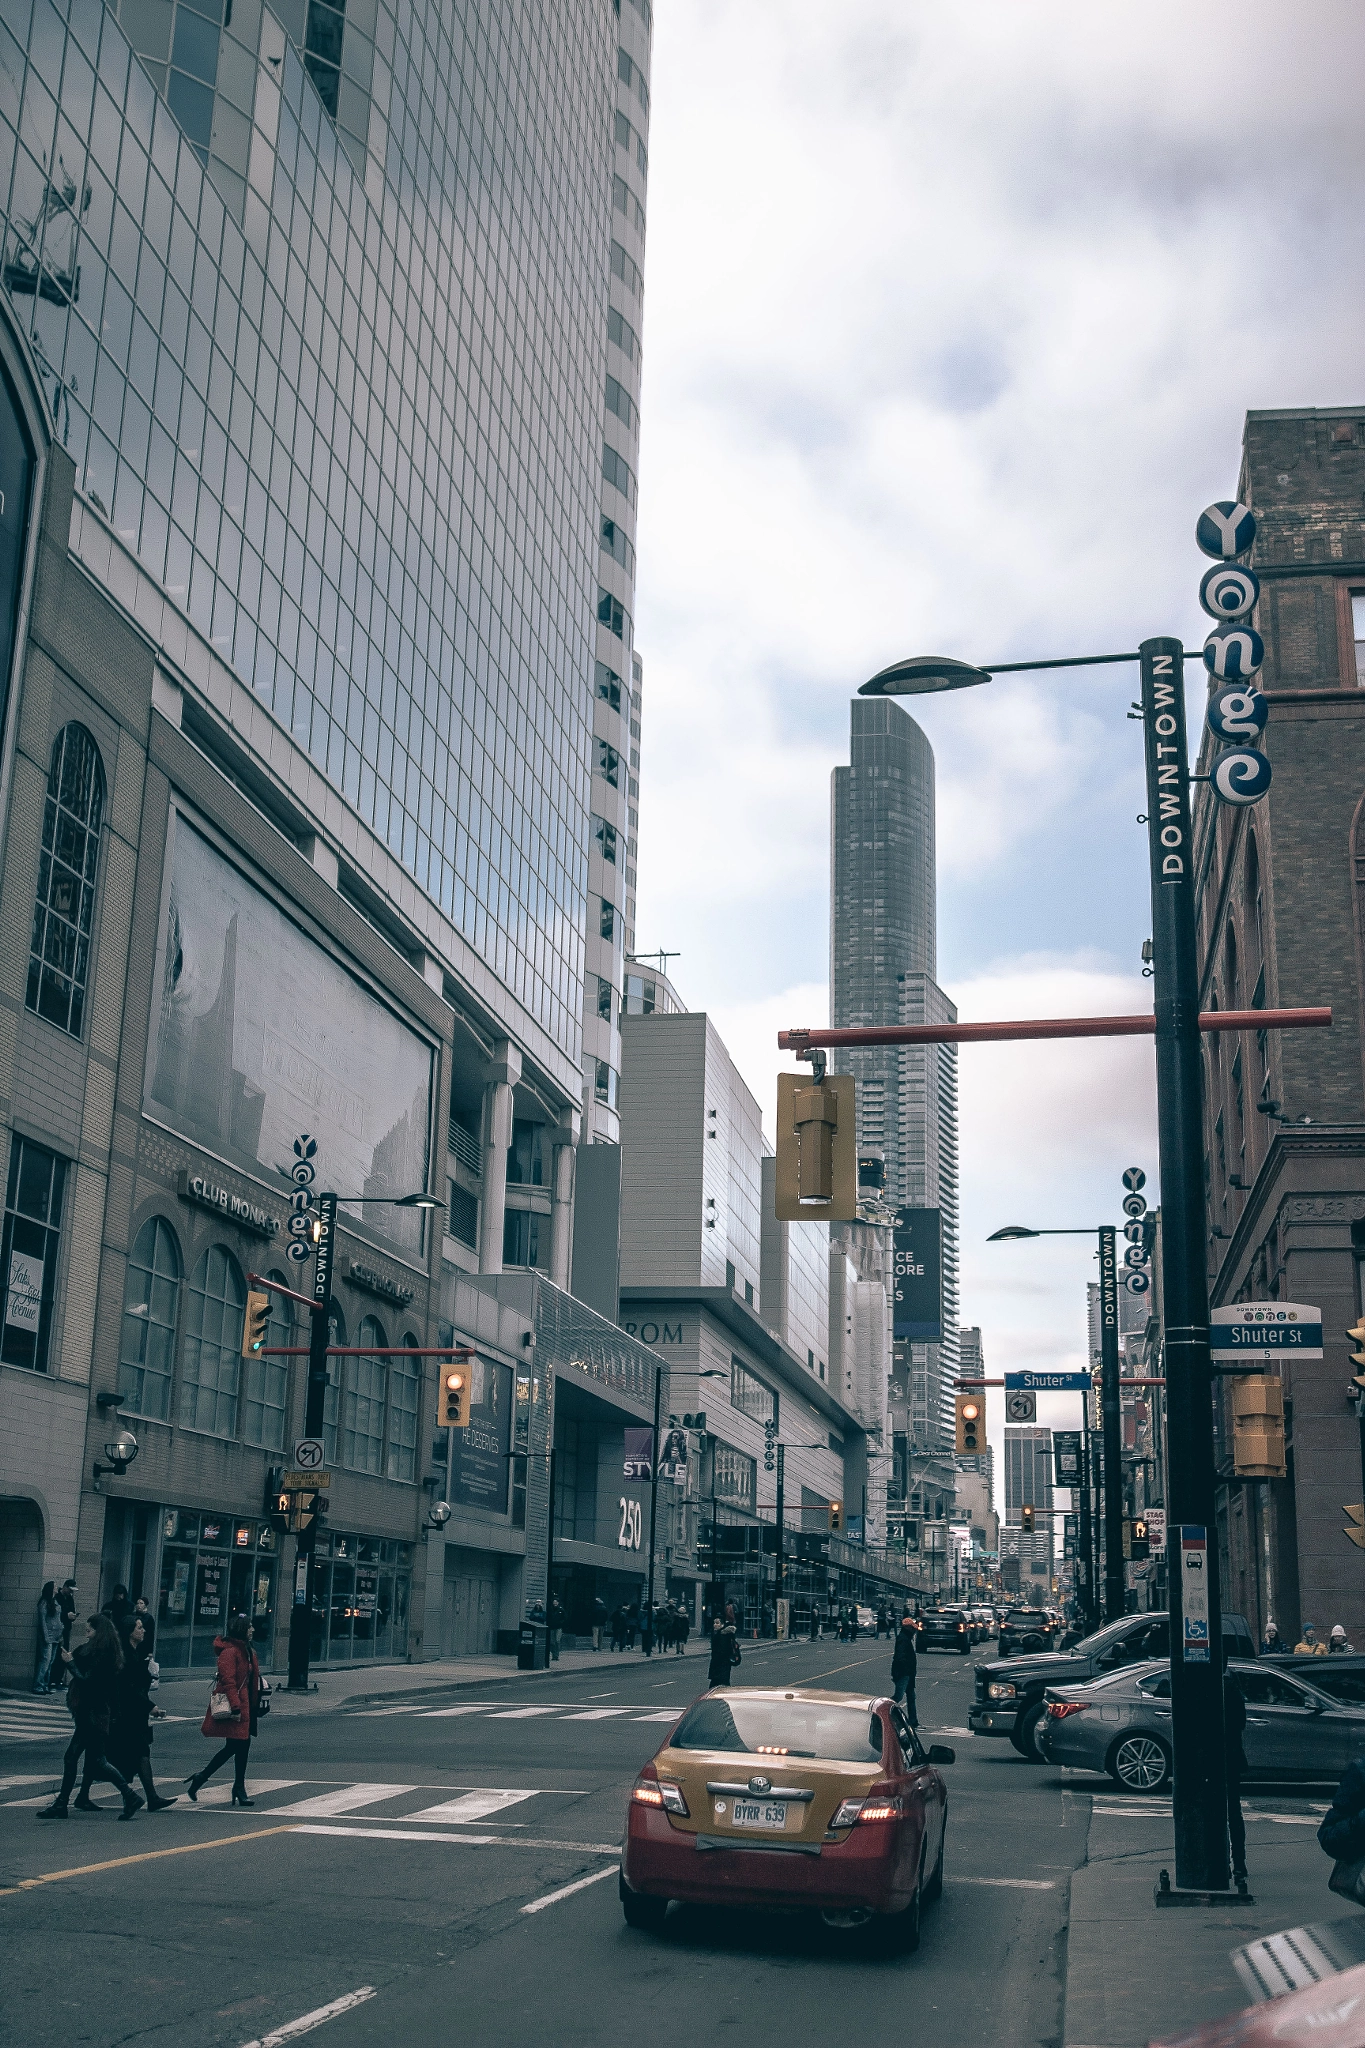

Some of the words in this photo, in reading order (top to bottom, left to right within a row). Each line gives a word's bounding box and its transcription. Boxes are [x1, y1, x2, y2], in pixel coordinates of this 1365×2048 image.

[1198, 502, 1270, 804] Yonge
[1152, 655, 1184, 874] DOWNTOWN
[191, 1176, 228, 1207] CLUB
[230, 1195, 281, 1235] MONACO
[286, 1134, 318, 1264] Yonge
[316, 1199, 331, 1294] DOWNTOWN
[1122, 1167, 1149, 1294] Yonge
[893, 1265, 925, 1275] ORE
[1104, 1232, 1114, 1326] DOWNTOWN
[1231, 1327, 1285, 1343] Shuter
[1289, 1329, 1302, 1343] St
[1264, 1350, 1271, 1359] 5
[1024, 1375, 1065, 1387] Shuter
[623, 1461, 687, 1478] STYLE
[618, 1497, 642, 1550] 250
[893, 1526, 904, 1537] 21
[734, 1804, 761, 1821] BYRR
[765, 1806, 785, 1822] 639
